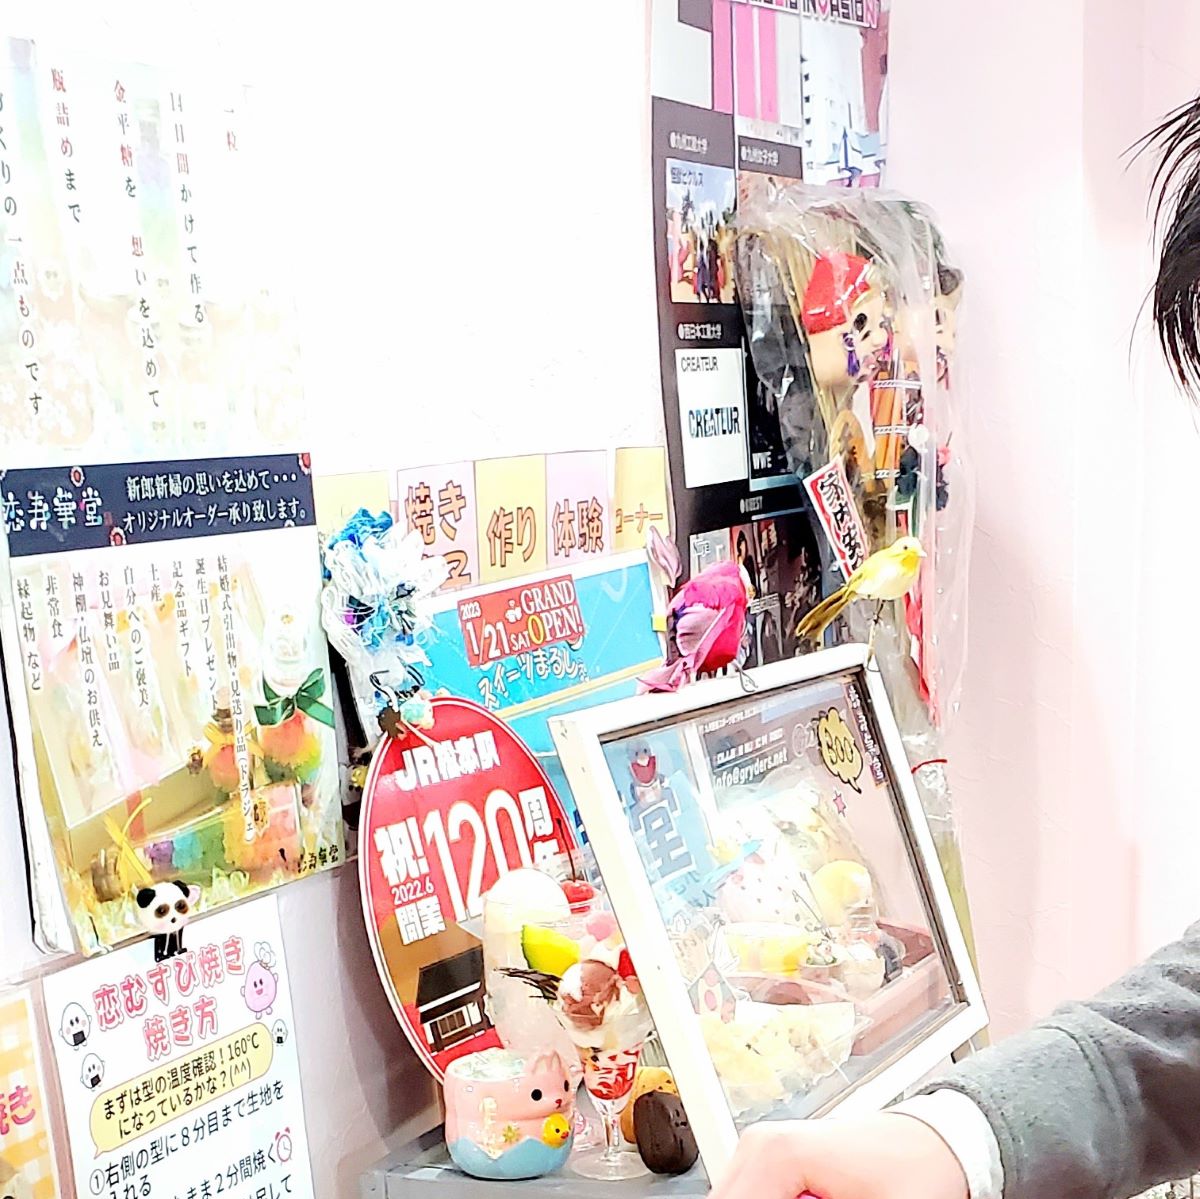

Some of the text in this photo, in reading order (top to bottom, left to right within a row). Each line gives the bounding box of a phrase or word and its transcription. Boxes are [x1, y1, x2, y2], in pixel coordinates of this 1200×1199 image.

[131, 235, 160, 408] 思いを込めて
[122, 498, 307, 534] オリジナルオーダー承り致します。
[486, 506, 538, 568] 作り
[552, 495, 605, 558] 体験
[614, 502, 665, 535] コーナー
[45, 575, 64, 640] 非常食
[98, 570, 121, 672] お見舞い品
[172, 560, 193, 677] 記念品ギフト
[520, 580, 576, 616] GRAND
[123, 565, 150, 708] 自分へのご褒美
[466, 603, 584, 662] 1/21 SAT OPEN!
[391, 879, 435, 906] 2022.6
[394, 895, 447, 946] 開業
[92, 935, 246, 1032] 恋むすび焼き
[142, 995, 219, 1062] 焼き方
